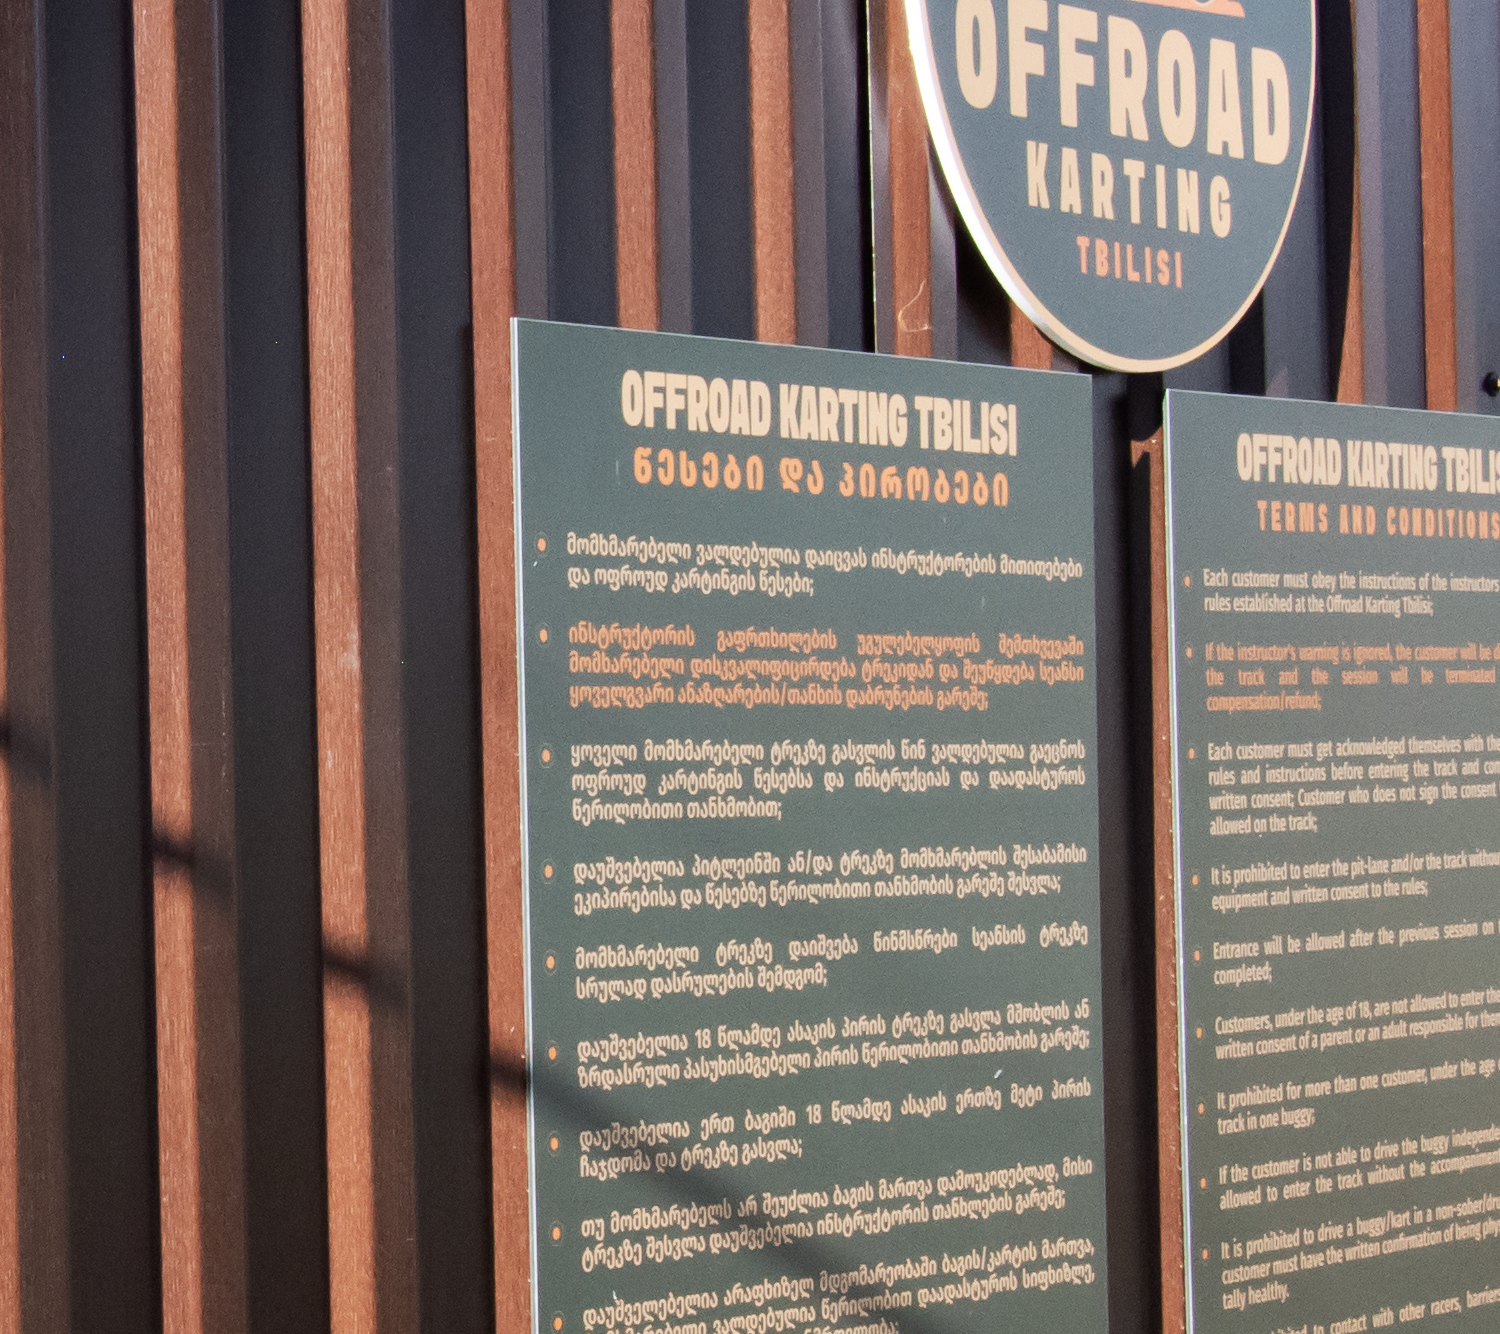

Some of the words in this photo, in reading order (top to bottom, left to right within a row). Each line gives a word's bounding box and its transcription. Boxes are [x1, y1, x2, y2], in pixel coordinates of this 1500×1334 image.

[1027, 141, 1232, 239] KARTING
[1076, 235, 1183, 289] TBILISI
[620, 368, 772, 437] OFFROAD
[778, 382, 908, 447] KARTING
[913, 395, 1018, 457] TBILISI
[632, 445, 764, 491] წესები
[778, 456, 824, 495] და
[838, 462, 1009, 507] პირობები
[1235, 432, 1342, 486] OFFROAD
[1346, 439, 1438, 491] KARTING
[1256, 499, 1328, 533] TERMS
[1339, 503, 1376, 535] AND
[1386, 506, 1500, 540] CONDITIONS
[566, 566, 591, 590] და
[1202, 567, 1229, 587] Each
[1230, 569, 1281, 588] customer
[1282, 571, 1309, 589] must
[1311, 569, 1337, 593] obey
[1338, 570, 1356, 589] the
[1358, 569, 1417, 591] instructions
[1417, 571, 1430, 591] of
[1430, 572, 1448, 592] the
[1449, 572, 1500, 593] instructors
[1203, 591, 1232, 612] rules
[1232, 591, 1294, 613] established
[1293, 595, 1306, 613] at
[1306, 593, 1325, 613] the
[1324, 593, 1364, 614] Offroad
[1364, 593, 1401, 618] Karting
[679, 887, 702, 910] და
[1212, 941, 1260, 960] Entrance
[1262, 934, 1283, 955] will
[1286, 934, 1302, 954] be
[1304, 929, 1346, 952] allowed
[1348, 927, 1374, 948] after
[1376, 926, 1395, 945] the
[1398, 921, 1440, 947] previous
[1442, 918, 1478, 939] session
[1481, 920, 1495, 936] on
[694, 1028, 712, 1049] 18
[1073, 997, 1090, 1019] ან
[580, 1217, 606, 1242] თუ
[737, 1194, 757, 1216] არ
[1371, 1306, 1394, 1328] with
